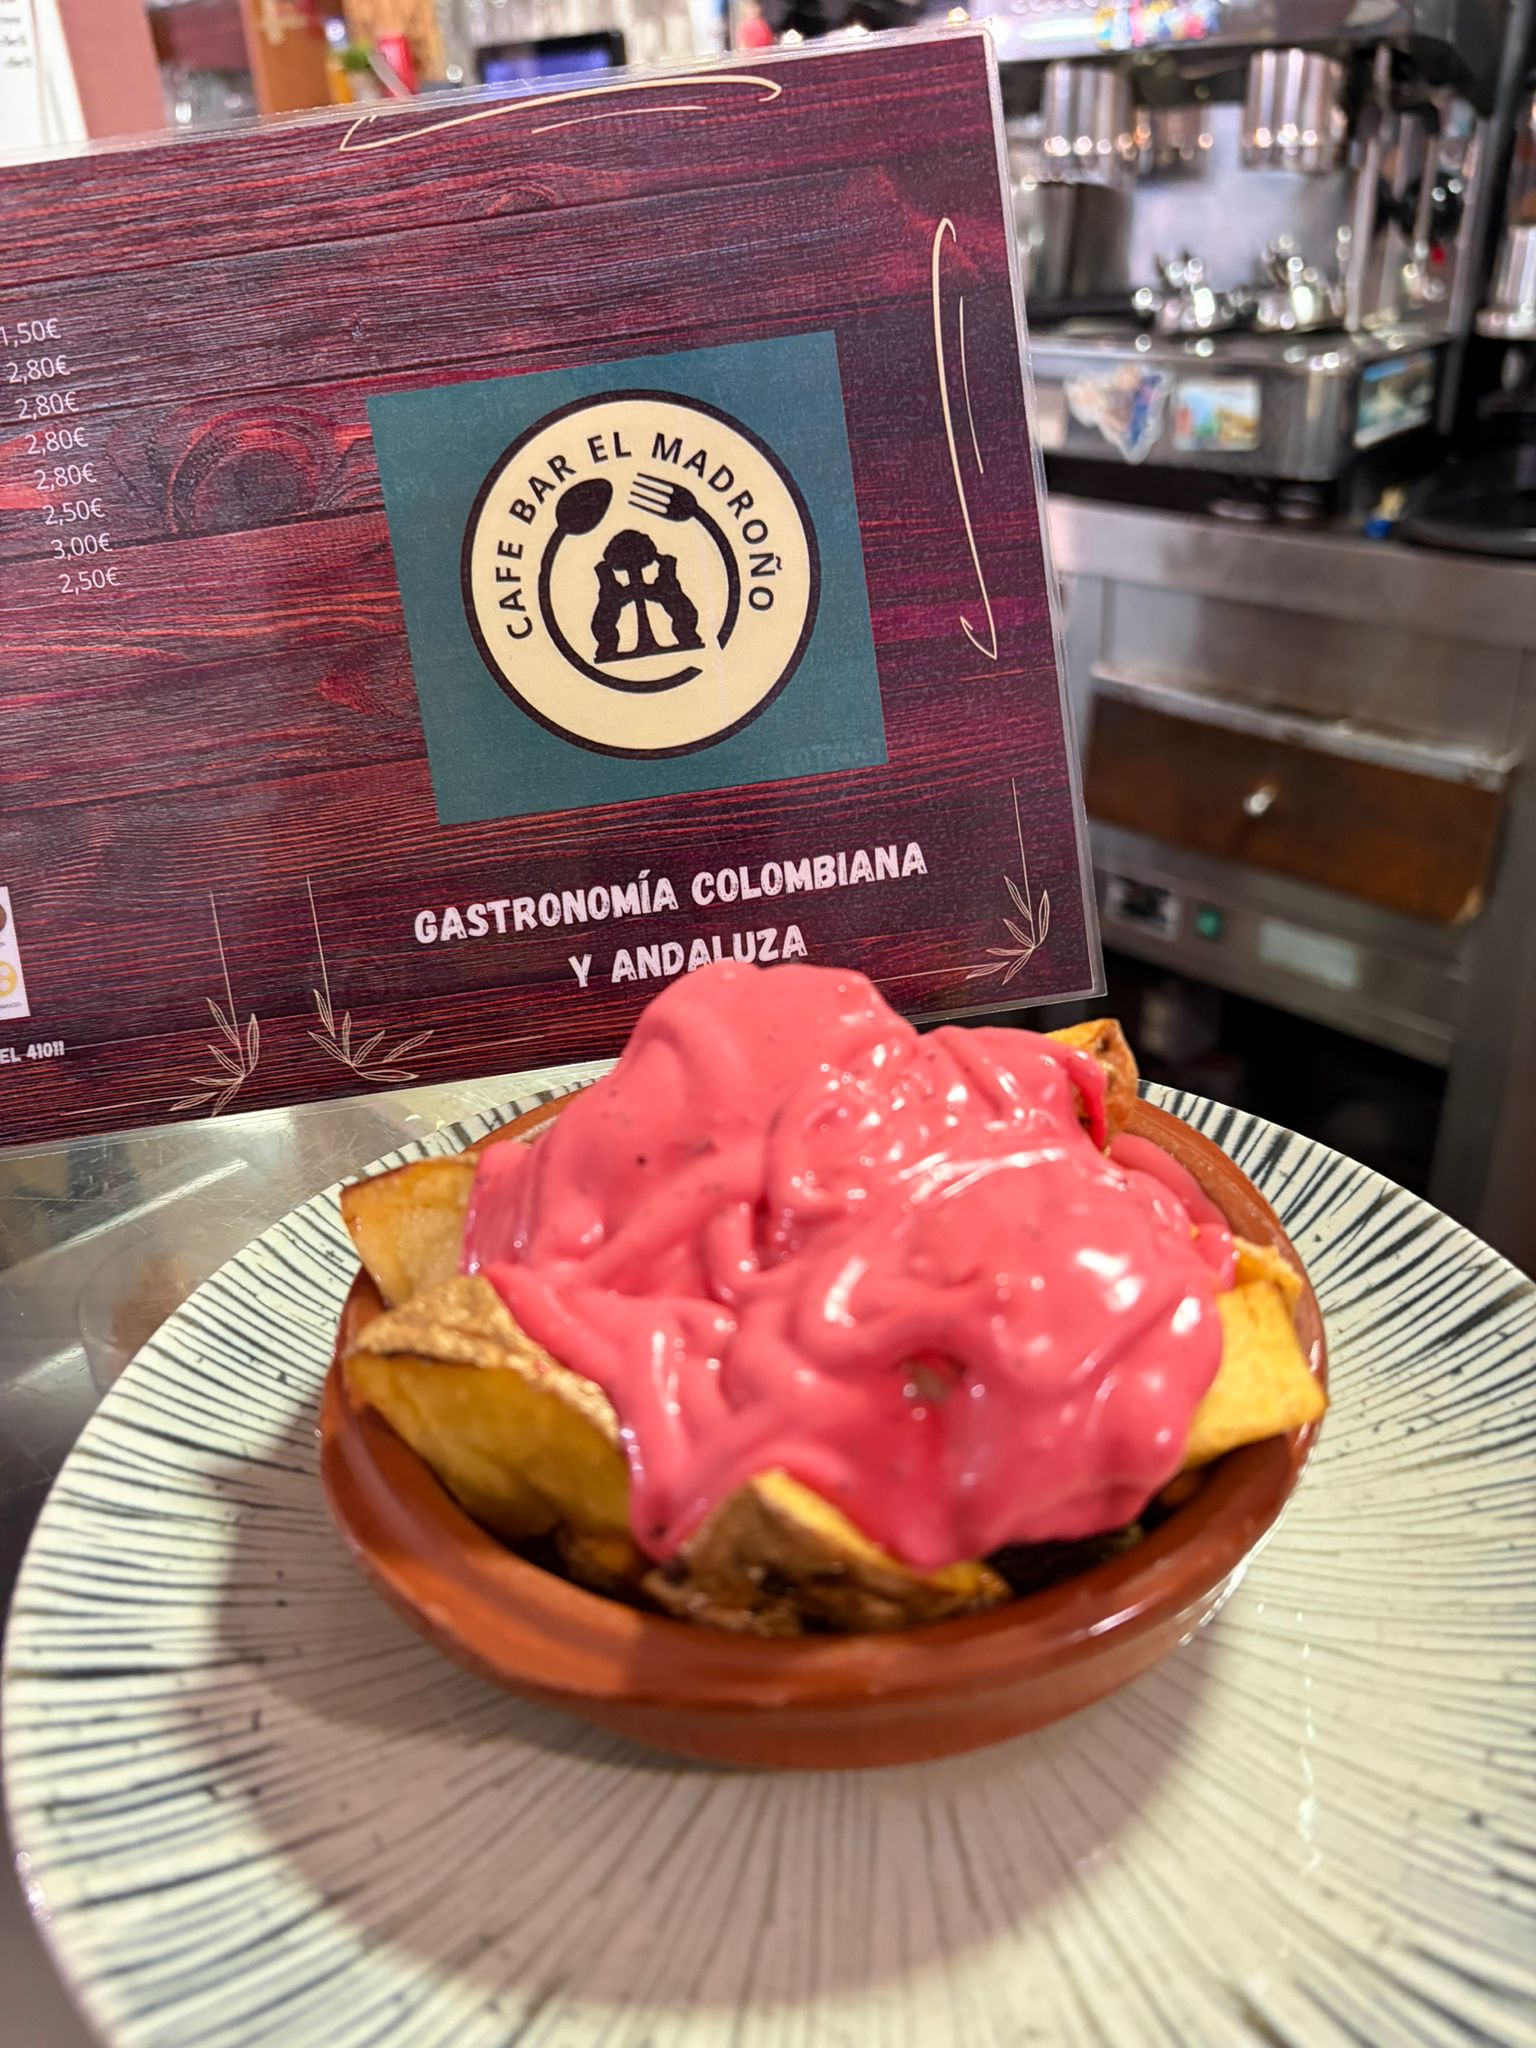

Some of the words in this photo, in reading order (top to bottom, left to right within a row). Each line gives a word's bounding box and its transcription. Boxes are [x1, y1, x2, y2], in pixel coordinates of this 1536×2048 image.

[0, 318, 62, 348] 1,50€
[6, 355, 71, 384] 2,80€
[15, 391, 80, 421] 2,80€
[24, 427, 89, 455] 2,80€
[587, 431, 632, 464] EL
[34, 463, 97, 491] 2,80€
[508, 454, 577, 525] BAR
[42, 498, 106, 526] 2,50€
[651, 432, 783, 612] MADROÑO
[50, 533, 113, 560] 3,00€
[57, 567, 121, 594] 2,50€
[495, 540, 533, 640] CAFE
[413, 868, 680, 945] GASTRONOMÍA
[690, 841, 928, 906] COLOMBIANA
[568, 953, 592, 988] Y
[611, 924, 808, 983] ANDALUZA
[26, 1040, 65, 1060] 41011
